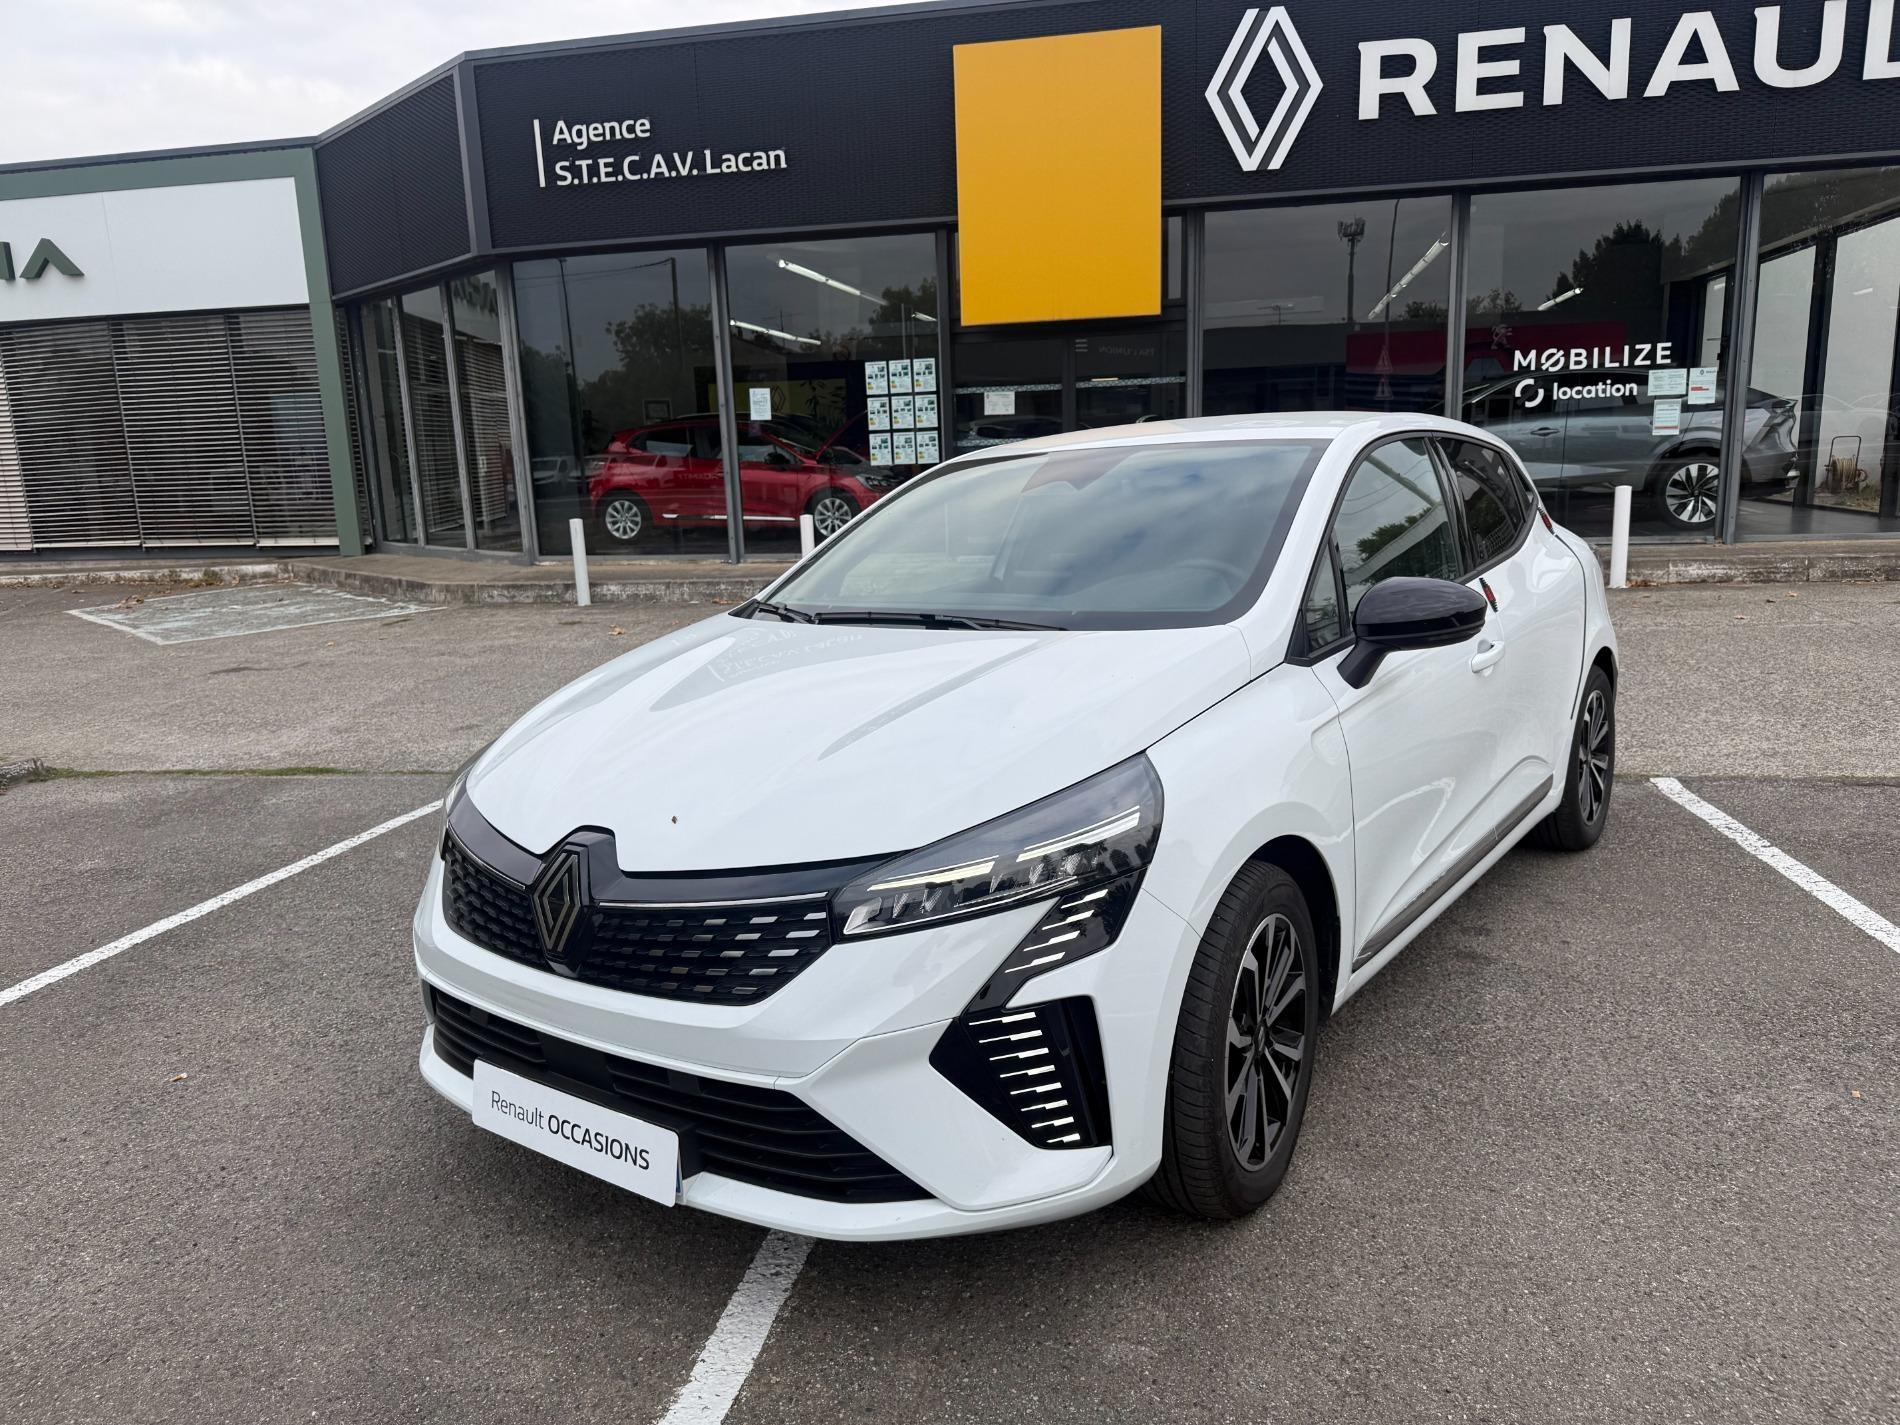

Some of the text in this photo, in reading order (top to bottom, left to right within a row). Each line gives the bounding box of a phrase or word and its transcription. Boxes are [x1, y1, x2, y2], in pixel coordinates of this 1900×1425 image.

[552, 117, 651, 150] Agence
[554, 148, 788, 186] S.T.E.C.A.V. Lacan
[1552, 379, 1638, 400] location
[491, 1090, 650, 1170] Renault OCCASIONS
